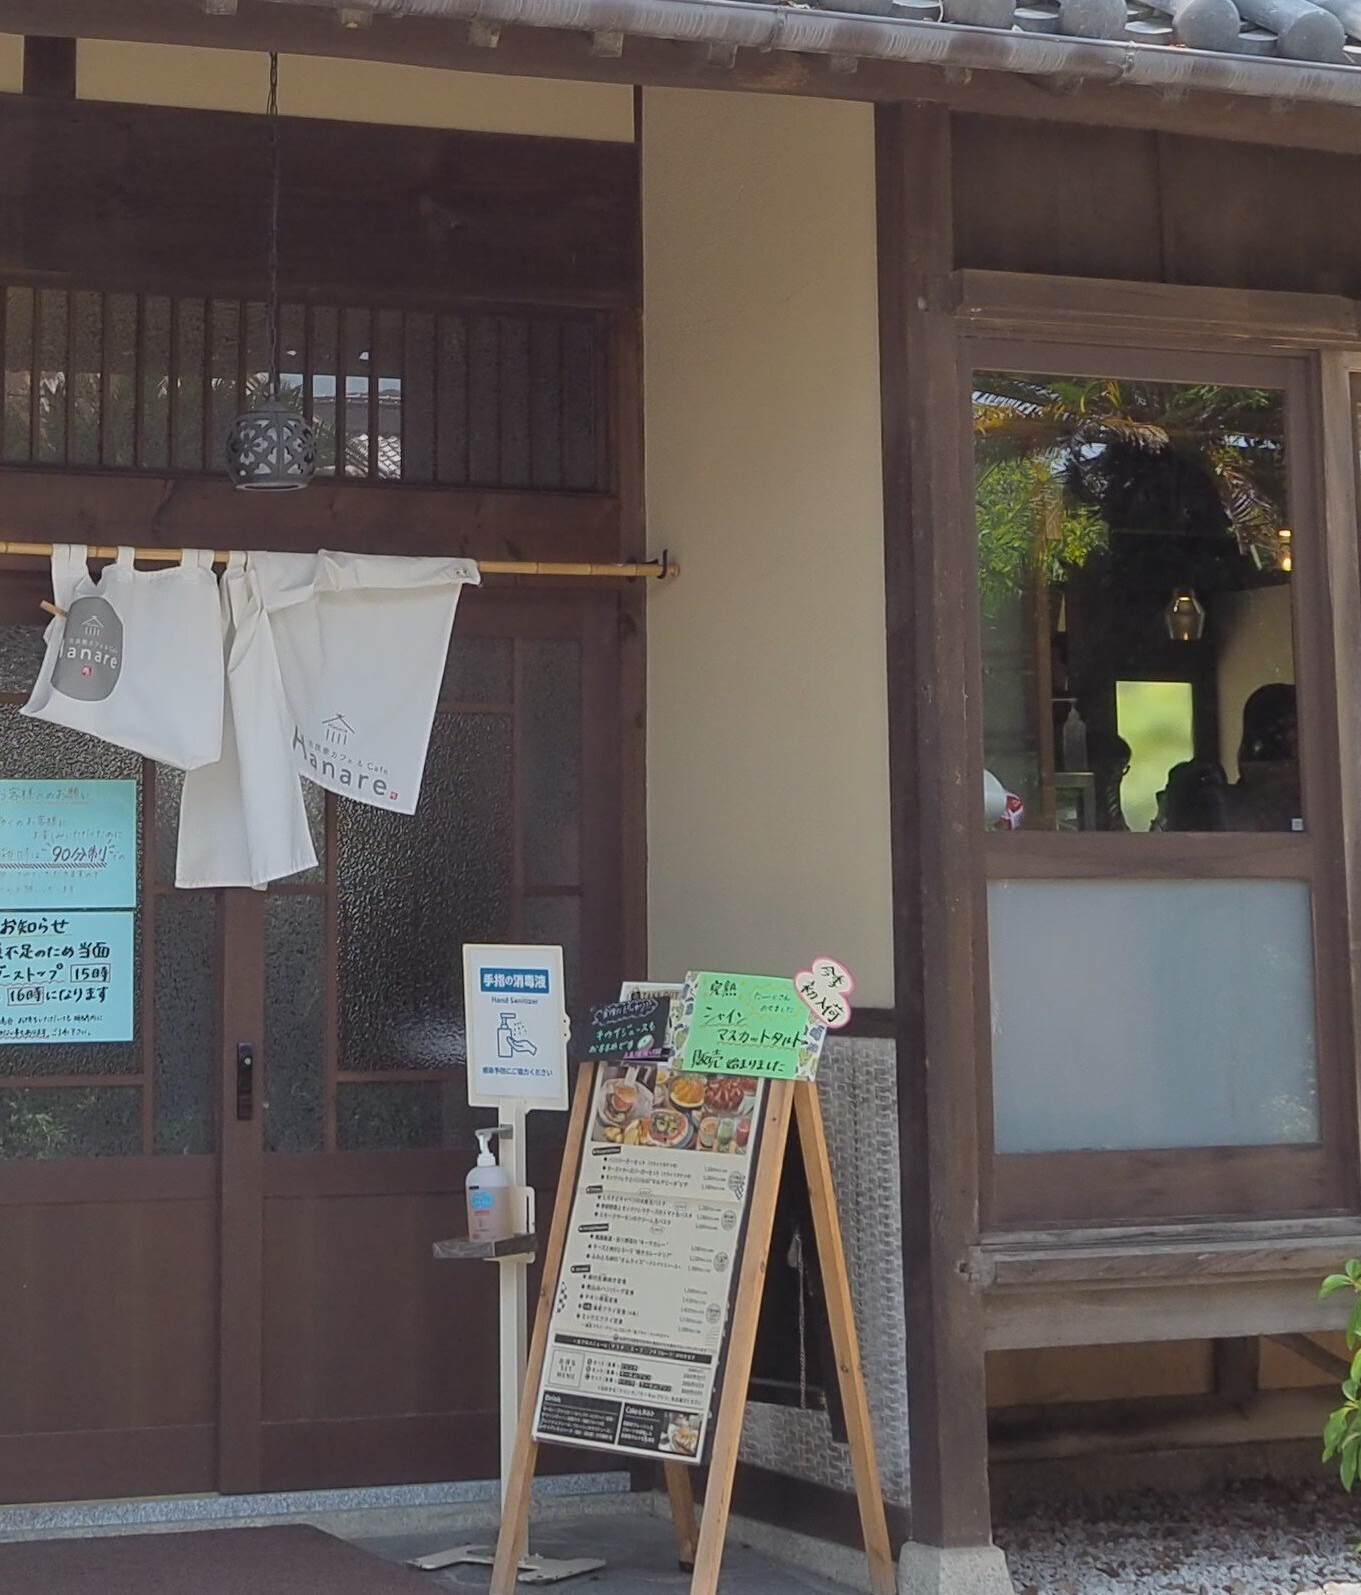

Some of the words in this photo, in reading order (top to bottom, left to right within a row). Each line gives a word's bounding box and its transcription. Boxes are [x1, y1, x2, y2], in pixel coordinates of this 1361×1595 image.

[293, 725, 387, 796] Hanare
[52, 845, 108, 862] 90分制
[0, 917, 69, 936] お知らせ
[74, 966, 108, 982] 15時
[483, 973, 547, 989] 手指の消毒液
[709, 980, 738, 997] 完熟
[491, 996, 509, 1004] Hand
[510, 997, 539, 1006] Sanitizer
[801, 981, 845, 1022] 初入荷
[703, 1007, 747, 1026] シャイン
[717, 1029, 803, 1049] マスカットタルト
